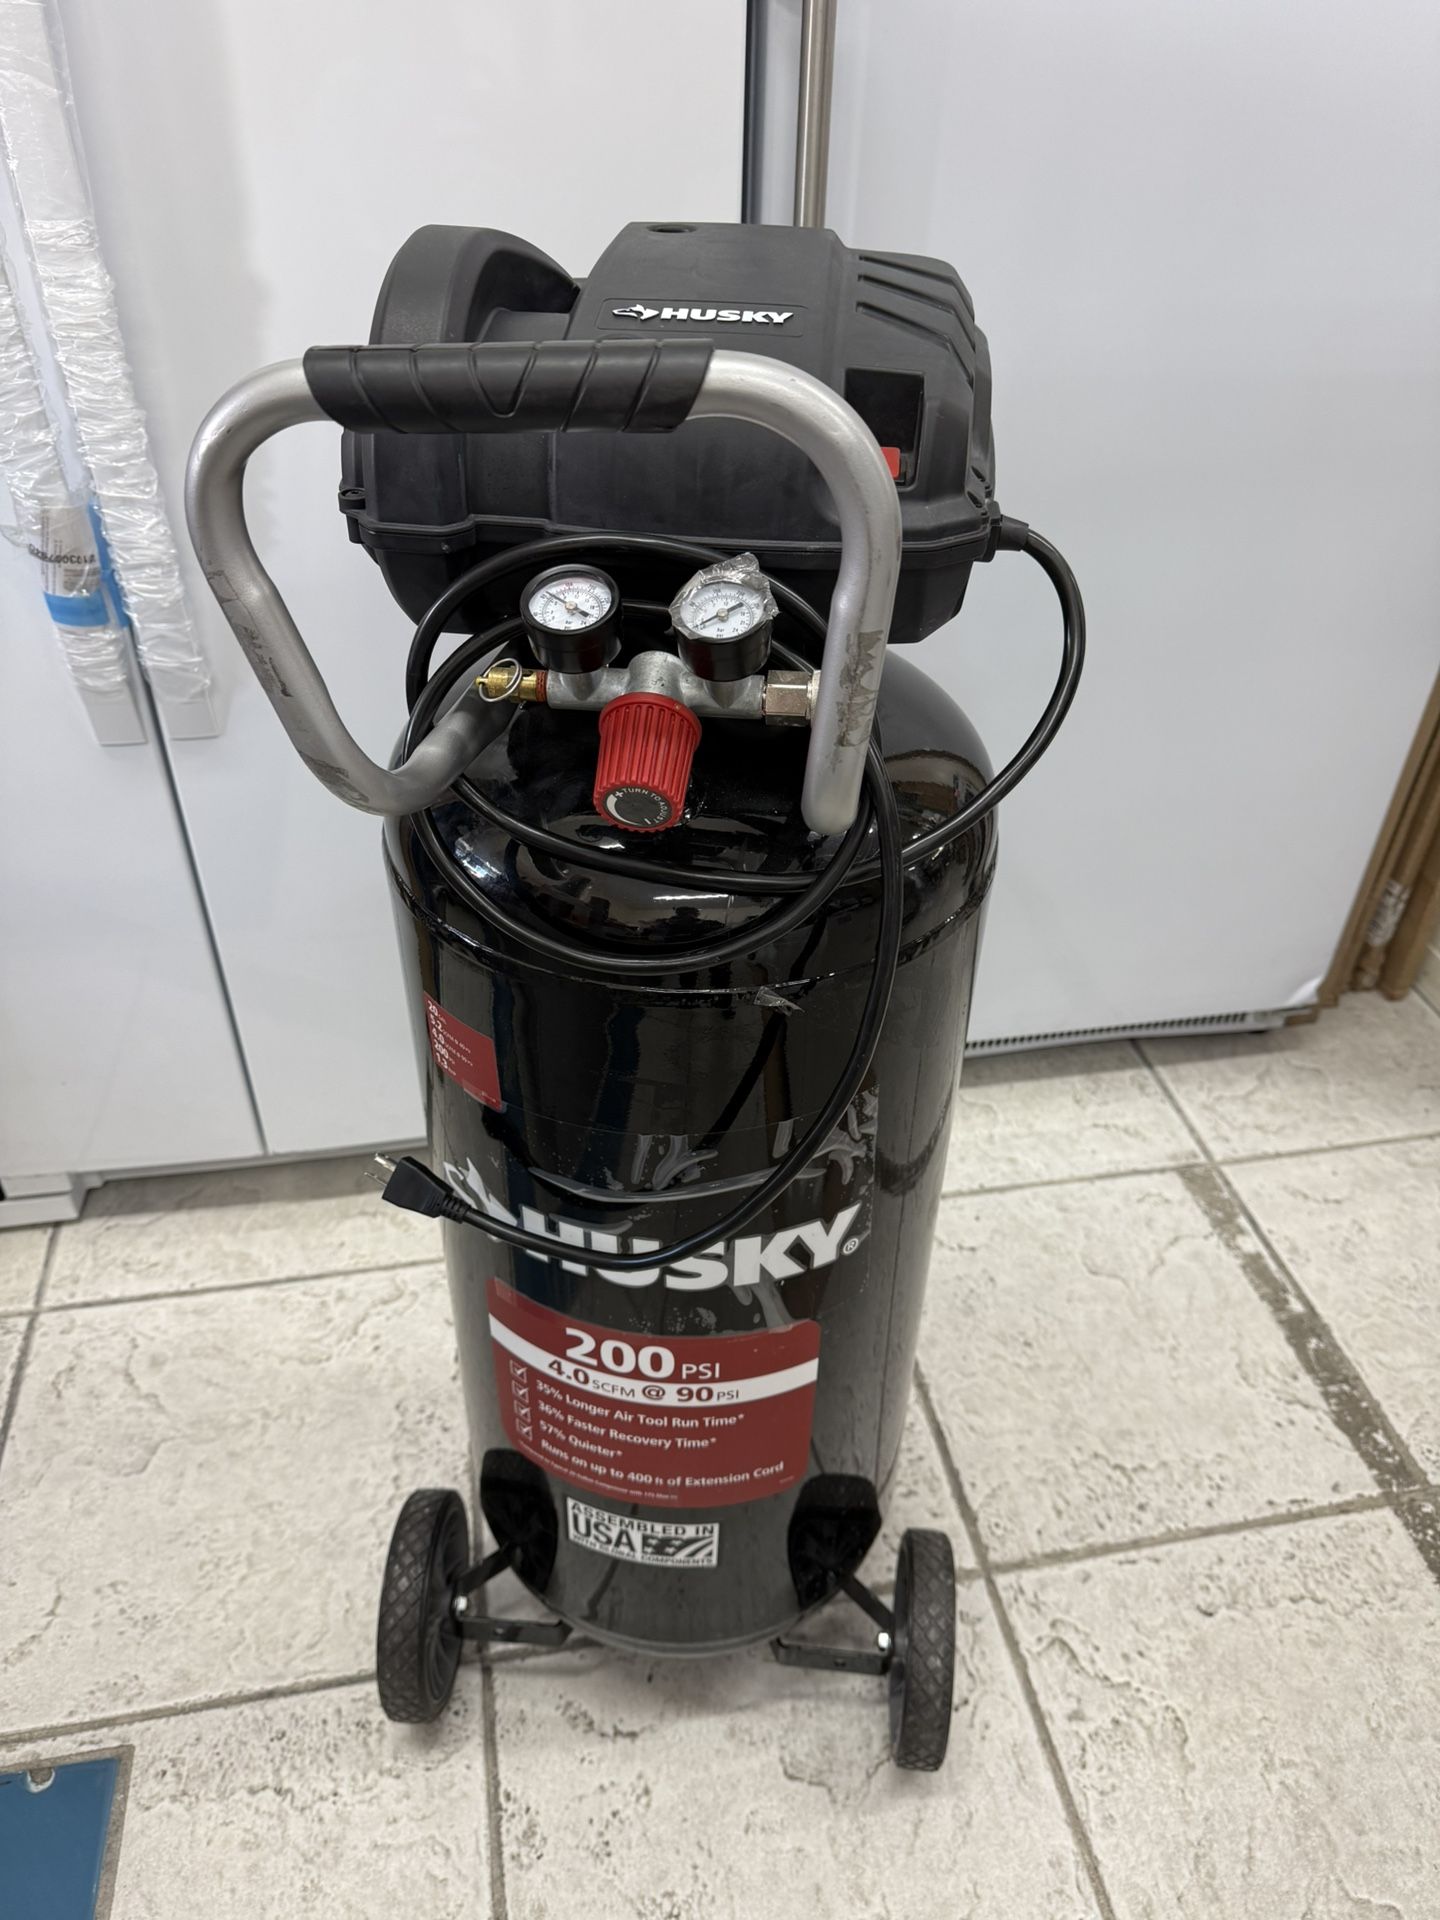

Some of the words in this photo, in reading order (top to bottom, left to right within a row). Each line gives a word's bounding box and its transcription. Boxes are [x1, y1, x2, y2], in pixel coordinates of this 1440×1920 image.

[660, 307, 794, 324] HUSKY
[621, 787, 649, 795] TURN
[650, 793, 662, 801] TO
[427, 1000, 438, 1016] 20
[434, 1039, 449, 1059] 200
[565, 1327, 675, 1379] 200
[681, 1362, 720, 1380] PSI
[548, 1359, 590, 1386] 4.0
[592, 1379, 635, 1398] SCFM
[641, 1385, 666, 1400] @
[676, 1386, 714, 1402] 90
[716, 1389, 739, 1401] PSI
[536, 1380, 563, 1400] 35%
[565, 1394, 611, 1417] Longer
[613, 1410, 634, 1422] Air
[637, 1414, 668, 1427] Tool
[671, 1416, 699, 1428] Run
[538, 1400, 565, 1421] 36%
[567, 1414, 606, 1436] Faster
[609, 1428, 672, 1450] Recovery
[540, 1420, 566, 1441] 57%
[541, 1439, 569, 1460] Runs
[571, 1456, 588, 1468] on
[590, 1462, 607, 1475] up
[610, 1468, 624, 1479] to
[627, 1471, 653, 1484] 400
[667, 1476, 682, 1487] of
[685, 1472, 750, 1487] Extension
[753, 1460, 784, 1478] Cord
[571, 1502, 686, 1536] ASSEMBLED
[695, 1525, 714, 1536] IN
[573, 1514, 637, 1552] USA
